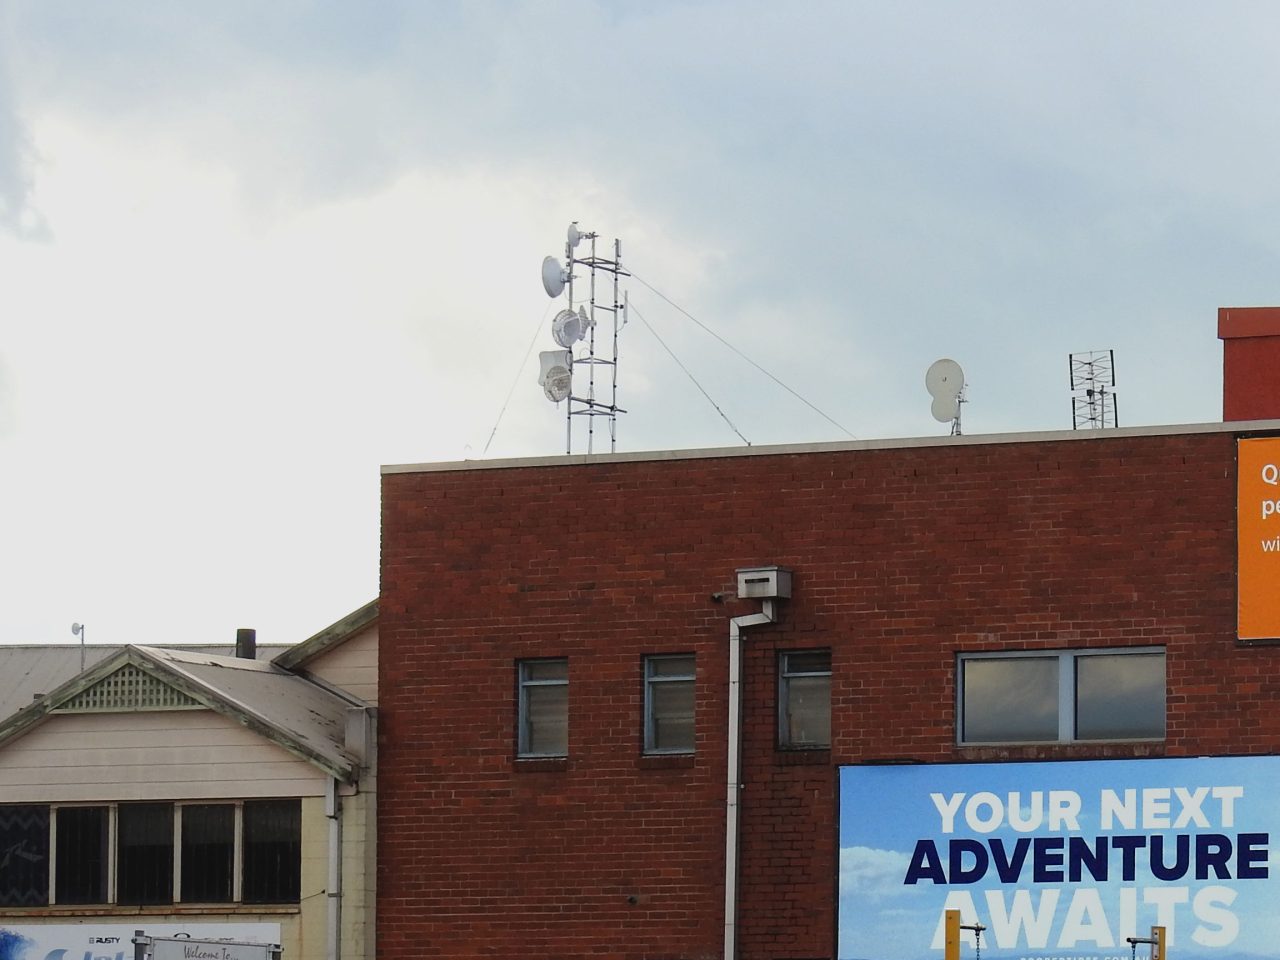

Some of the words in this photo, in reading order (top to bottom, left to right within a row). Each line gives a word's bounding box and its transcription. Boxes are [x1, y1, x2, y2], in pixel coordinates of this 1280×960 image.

[930, 790, 1082, 833] YOUR
[1101, 786, 1244, 830] NEXT
[903, 833, 1270, 885] ADVENTURE
[96, 937, 121, 945] RUSTY
[930, 885, 1240, 950] AWAITS
[184, 945, 219, 960] Welcome
